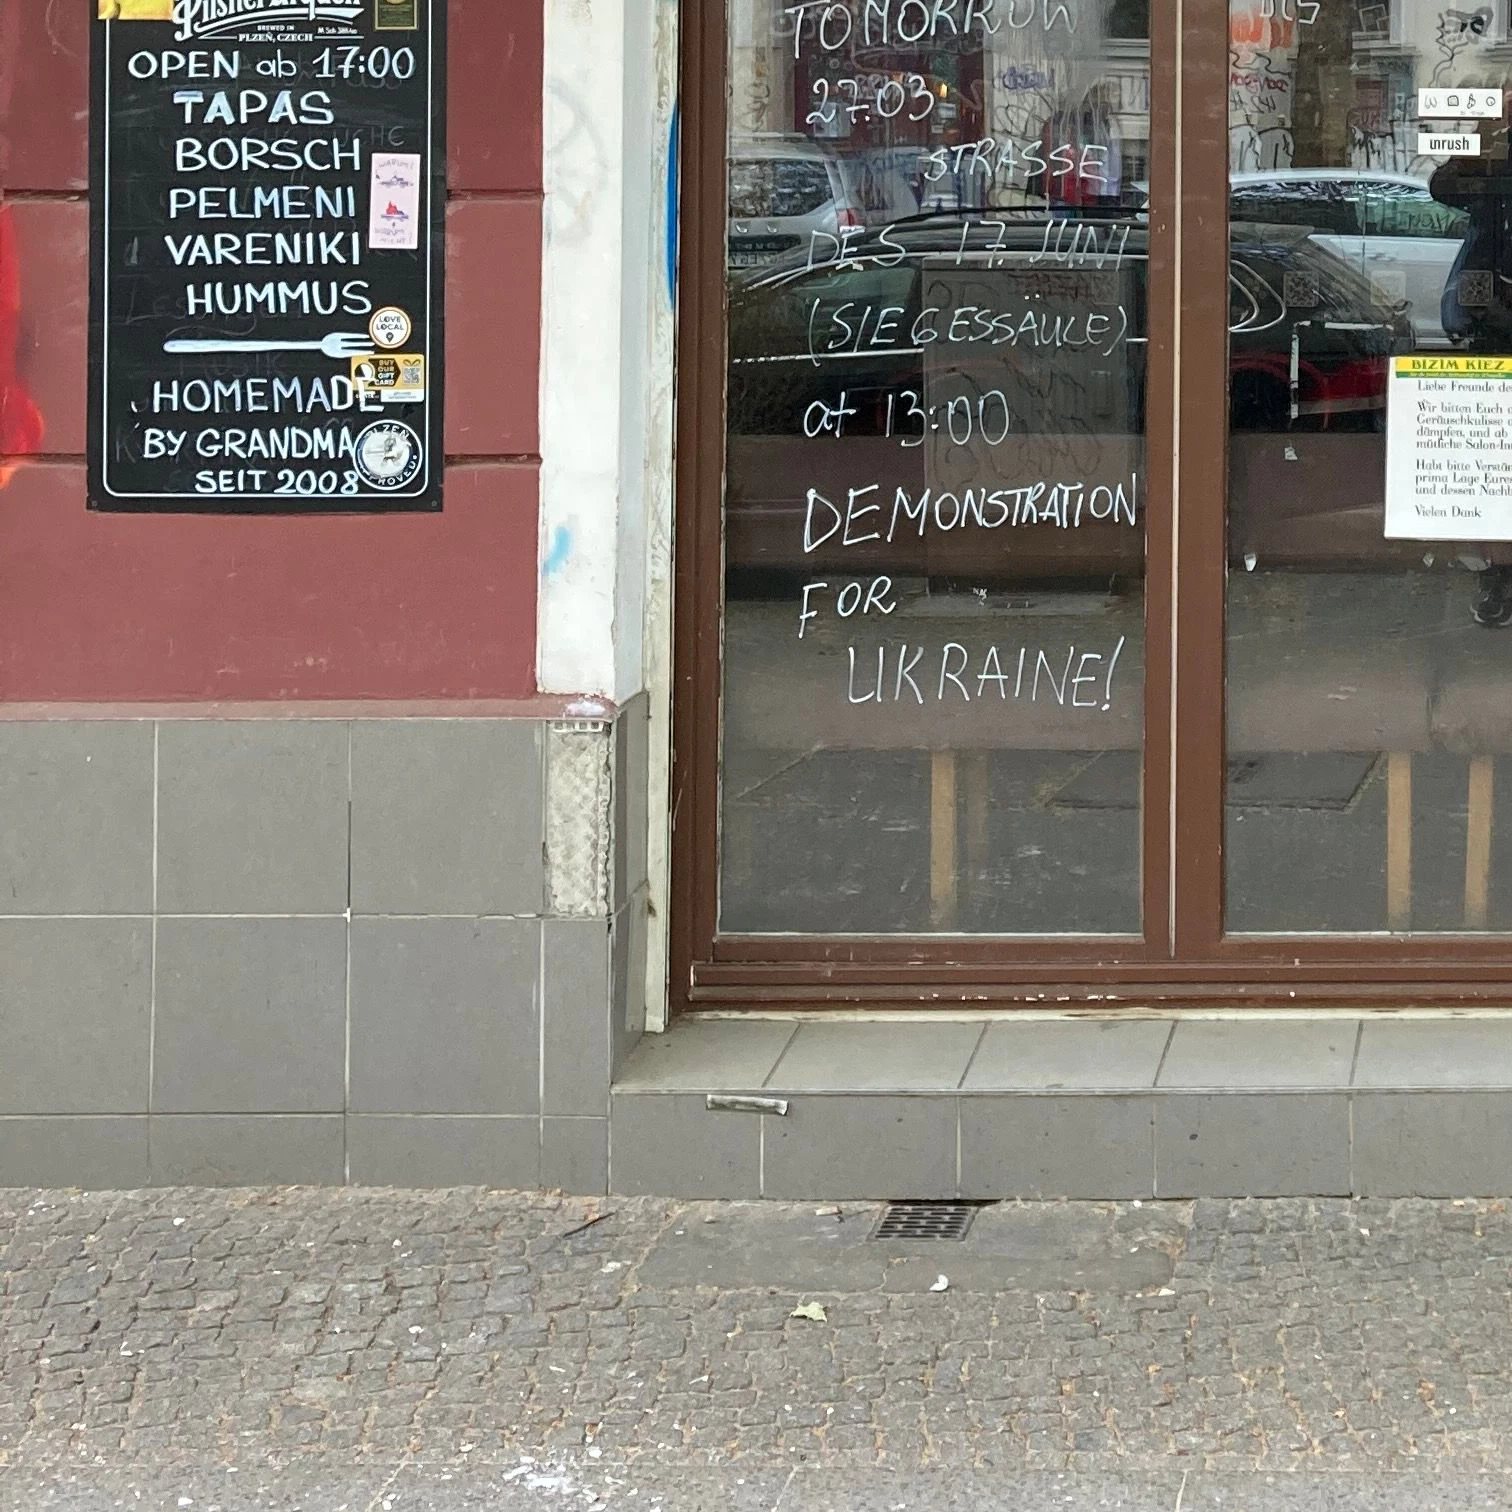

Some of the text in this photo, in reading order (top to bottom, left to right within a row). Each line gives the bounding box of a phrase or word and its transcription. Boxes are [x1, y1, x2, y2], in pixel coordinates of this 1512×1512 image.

[257, 24, 295, 32] BREWED IN
[277, 33, 313, 42] CZECH
[128, 45, 416, 79] OPEN ab 17:00
[173, 89, 335, 126] TAPAS
[805, 74, 935, 126] 27.03
[175, 138, 361, 172] BORSCH
[924, 137, 1108, 183] STRASSE
[169, 185, 356, 219] PELMENI
[164, 231, 361, 266] VARENIKI
[806, 224, 906, 273] DES
[1029, 219, 1131, 272] JUNI
[186, 280, 373, 316] HUMMUS
[376, 323, 405, 331] LOCAL
[379, 315, 401, 323] LOVE
[153, 377, 385, 414] HOMEMADE
[1418, 380, 1447, 392] Liebe
[1450, 380, 1495, 393] Freunde
[803, 390, 1009, 447] at 13:00
[1416, 414, 1502, 427] Geräuschkulisse
[1417, 401, 1437, 414] Wir
[1441, 402, 1471, 414] bitten
[1476, 402, 1503, 415] Euch
[144, 426, 357, 460] BY GRANDMA
[1469, 426, 1490, 438] und
[1494, 426, 1508, 439] ab
[195, 468, 359, 495] SEIT 2008
[1415, 459, 1443, 471] Habt
[1447, 459, 1471, 471] bitte
[1415, 473, 1449, 485] prima
[1452, 474, 1480, 486] Lage
[1415, 484, 1437, 496] und
[1440, 484, 1476, 496] dessen
[802, 473, 1137, 553] DEMONSTRATION
[1414, 504, 1482, 519] Vielen Dank
[798, 575, 896, 639] FOR
[847, 635, 1125, 711] UKRAINE!
